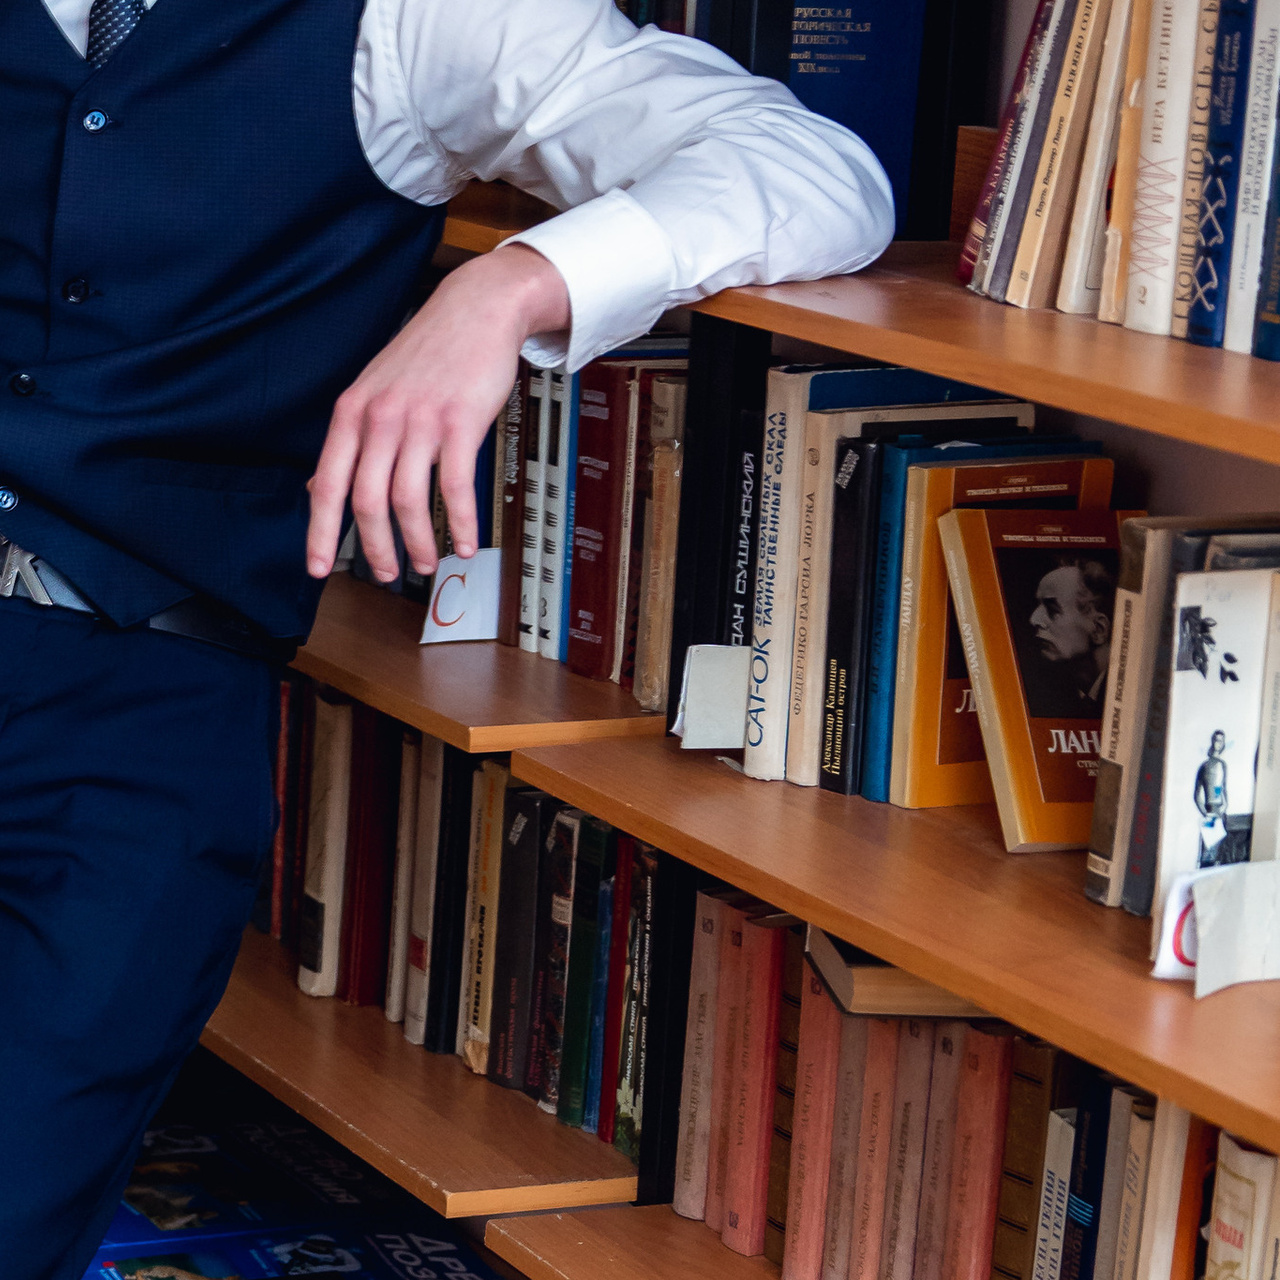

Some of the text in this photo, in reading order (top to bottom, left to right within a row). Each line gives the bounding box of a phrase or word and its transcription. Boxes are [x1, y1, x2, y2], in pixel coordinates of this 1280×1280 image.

[793, 35, 848, 44] ПОВЕСТЬ
[794, 8, 852, 18] РУССКАЯ
[798, 63, 816, 72] XIX
[1063, 35, 1085, 98] ПОДОБНО
[1253, 39, 1266, 97] ХОТЕЛИ
[1259, 28, 1278, 128] НЕНАВИДЕЛИ
[987, 119, 1016, 187] КАЗАКЕВИЧ
[1150, 99, 1165, 144] ВЕРА
[1138, 285, 1148, 305] 2
[735, 453, 755, 593] СУШИНСКИЙ
[754, 412, 778, 627] ЗЕМЛЯ СОЛЕНЫХ СКАЛ
[763, 412, 787, 627] ТАИНСТВЕННЫЕ СЛЕДЫ
[431, 574, 467, 627] С
[792, 491, 815, 715] ФЕДЕРИКО ГАРСИА ЛОРКА
[901, 575, 913, 628] ЛАНДАУ
[749, 634, 771, 747] САТ-ОК
[822, 658, 839, 772] Александр Казанцев
[831, 669, 847, 774] Пылающий остров
[1108, 708, 1120, 759] ВАДИМ
[626, 1036, 634, 1083] МИЛОСЛАВ
[683, 992, 708, 1183] ПРОИСХОЖДЕНИЕ МАСТЕРА
[866, 1092, 881, 1161] МАСТЕРА
[896, 1102, 911, 1173] МАСТЕРА
[928, 1119, 943, 1190] МАСТЕРА
[1040, 1169, 1055, 1228] ГЕНИЯ
[1052, 1178, 1066, 1239] ГЕНИЯ
